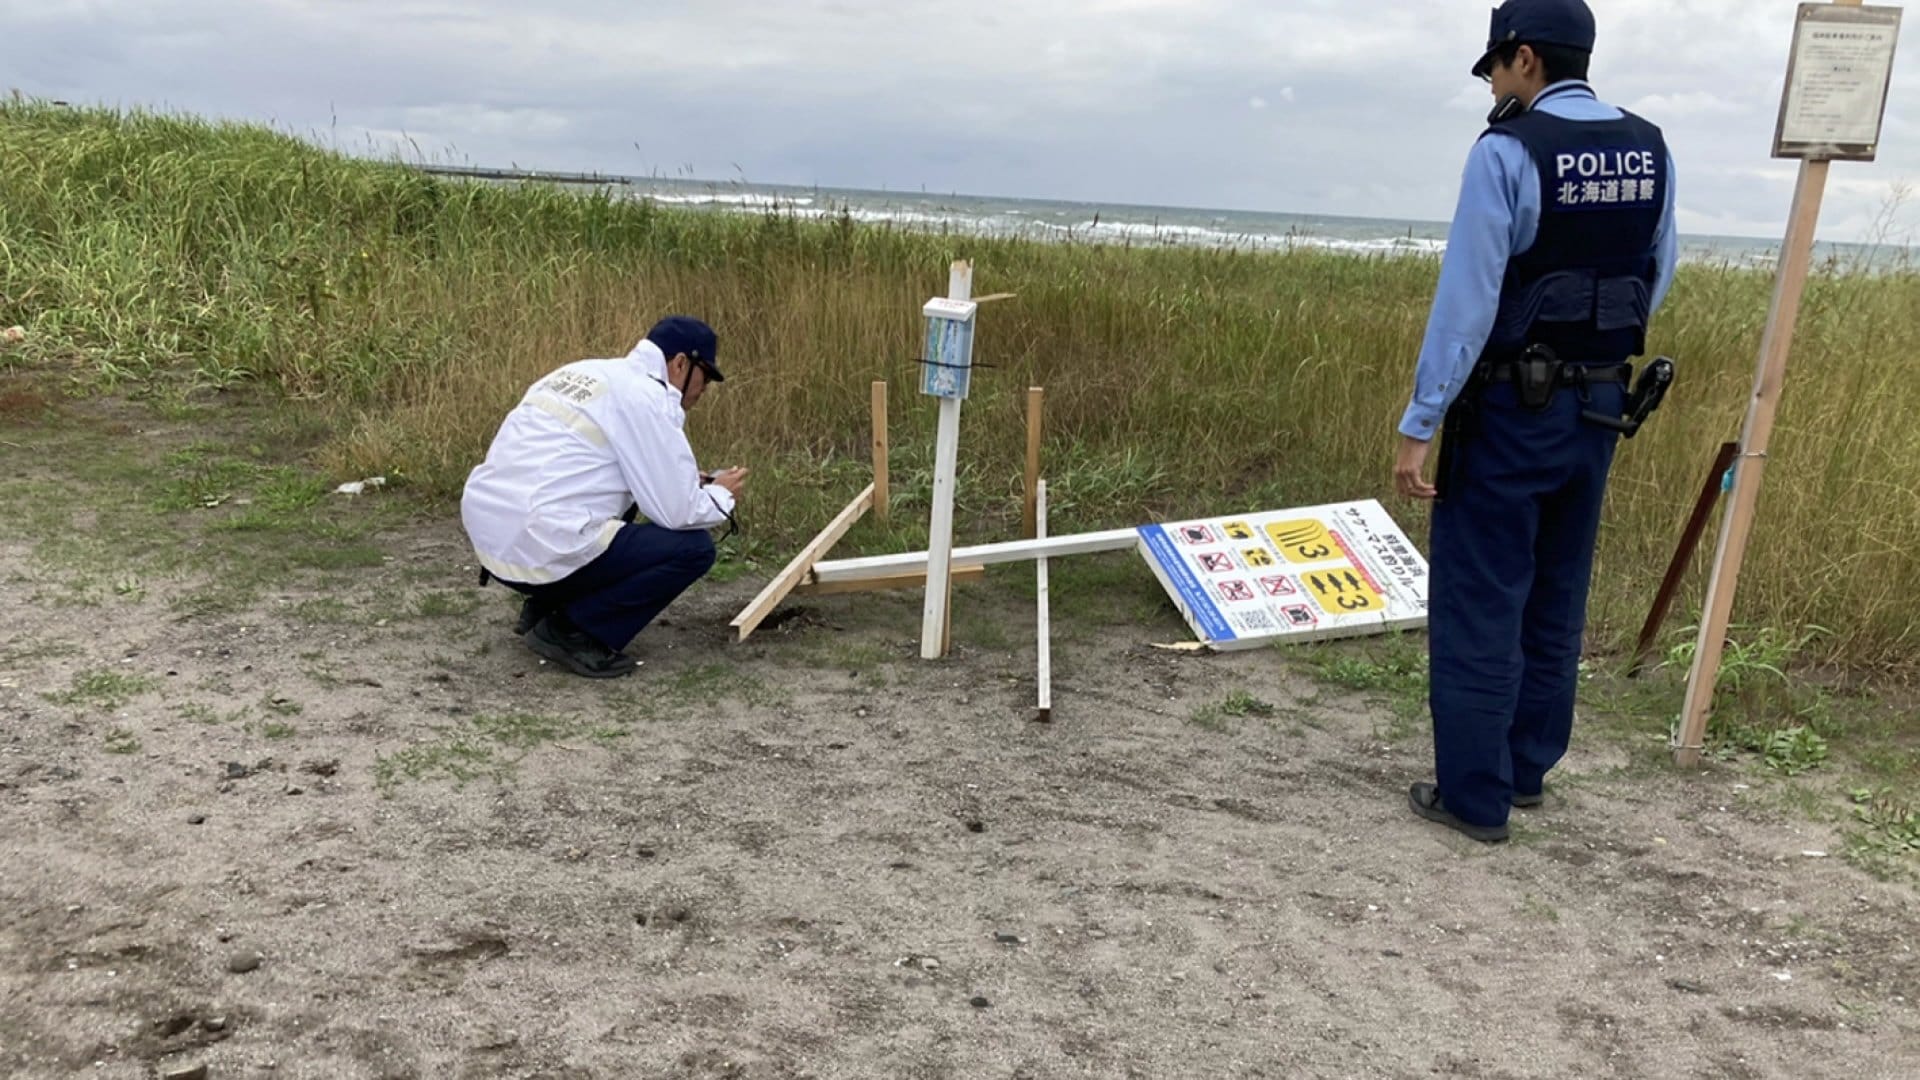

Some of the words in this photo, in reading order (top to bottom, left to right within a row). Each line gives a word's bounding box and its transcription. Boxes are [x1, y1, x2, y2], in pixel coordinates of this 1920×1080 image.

[1557, 151, 1655, 178] POLICE
[1557, 178, 1655, 204] 北海道警察
[1299, 544, 1330, 559] 3
[1337, 595, 1369, 610] 3
